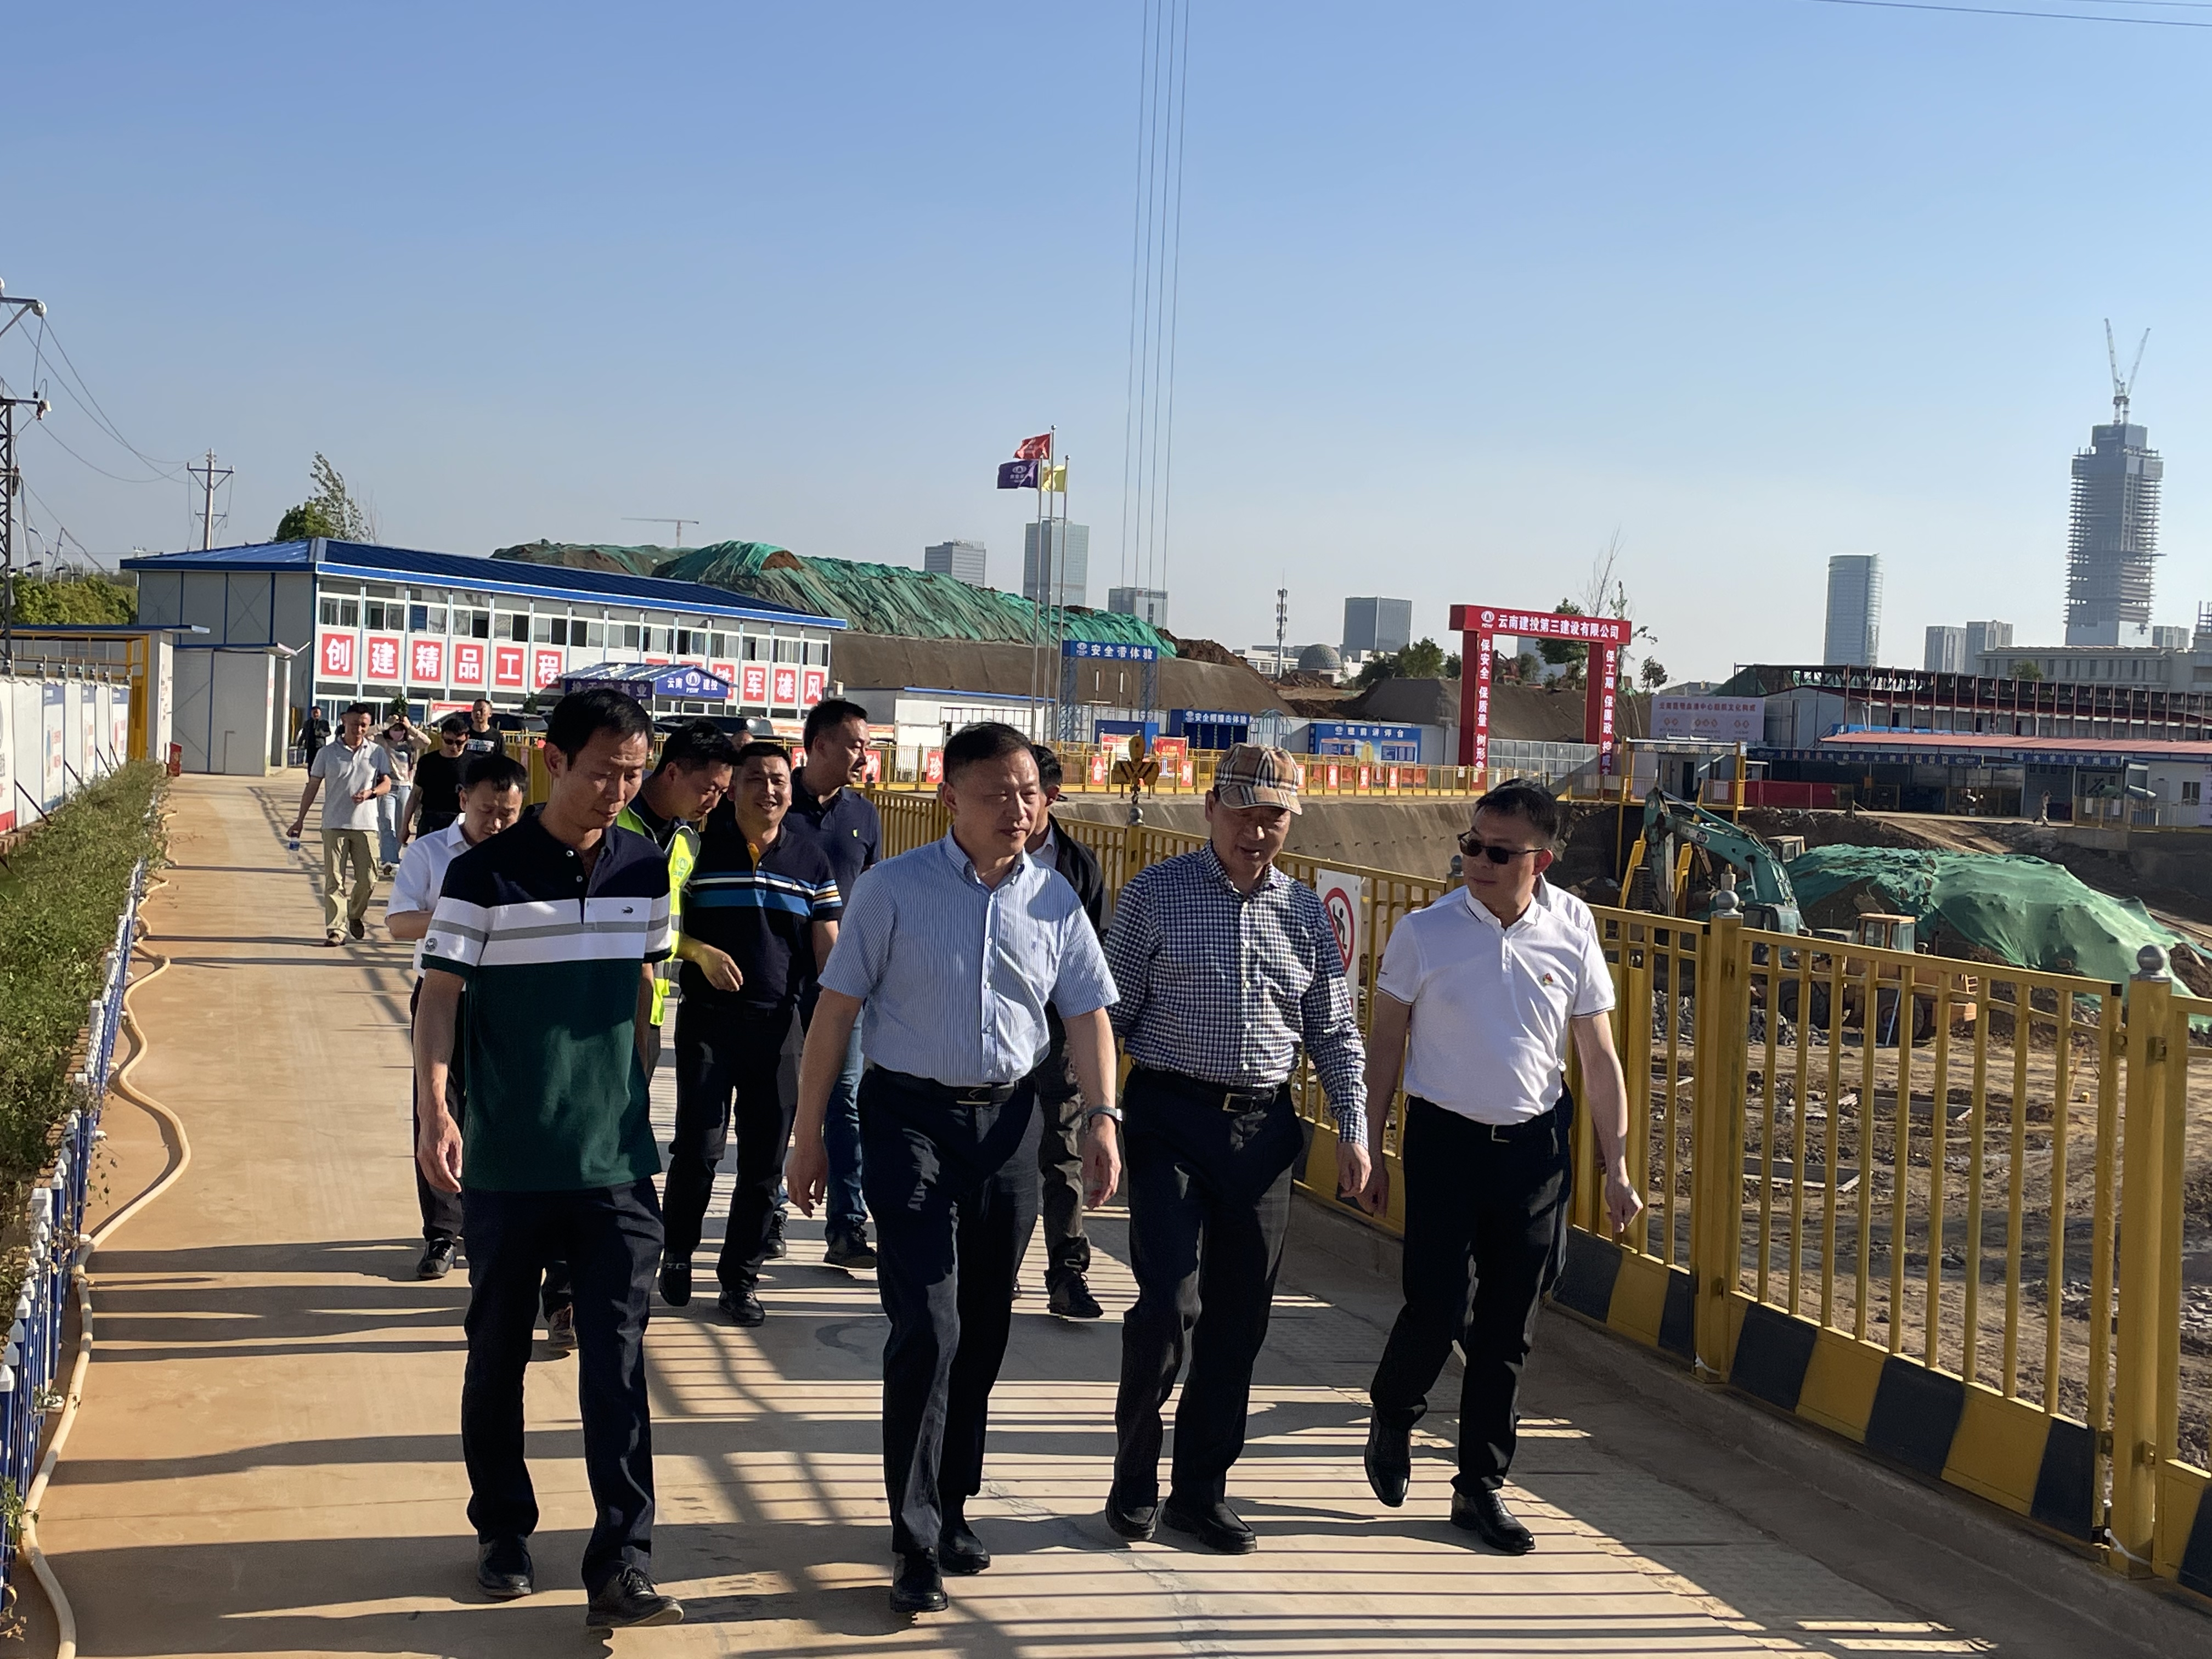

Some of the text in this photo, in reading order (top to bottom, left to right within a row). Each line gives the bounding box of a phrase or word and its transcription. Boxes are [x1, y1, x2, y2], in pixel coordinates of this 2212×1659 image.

[1498, 614, 1618, 640] 云南建投第三建设有限公司
[325, 638, 560, 685] 创建精品工程
[1091, 644, 1153, 659] 安全带体验
[1480, 639, 1491, 680] 保安全
[1604, 650, 1615, 690] 保工期
[667, 676, 683, 690] 云南
[1478, 686, 1489, 727] 保质量
